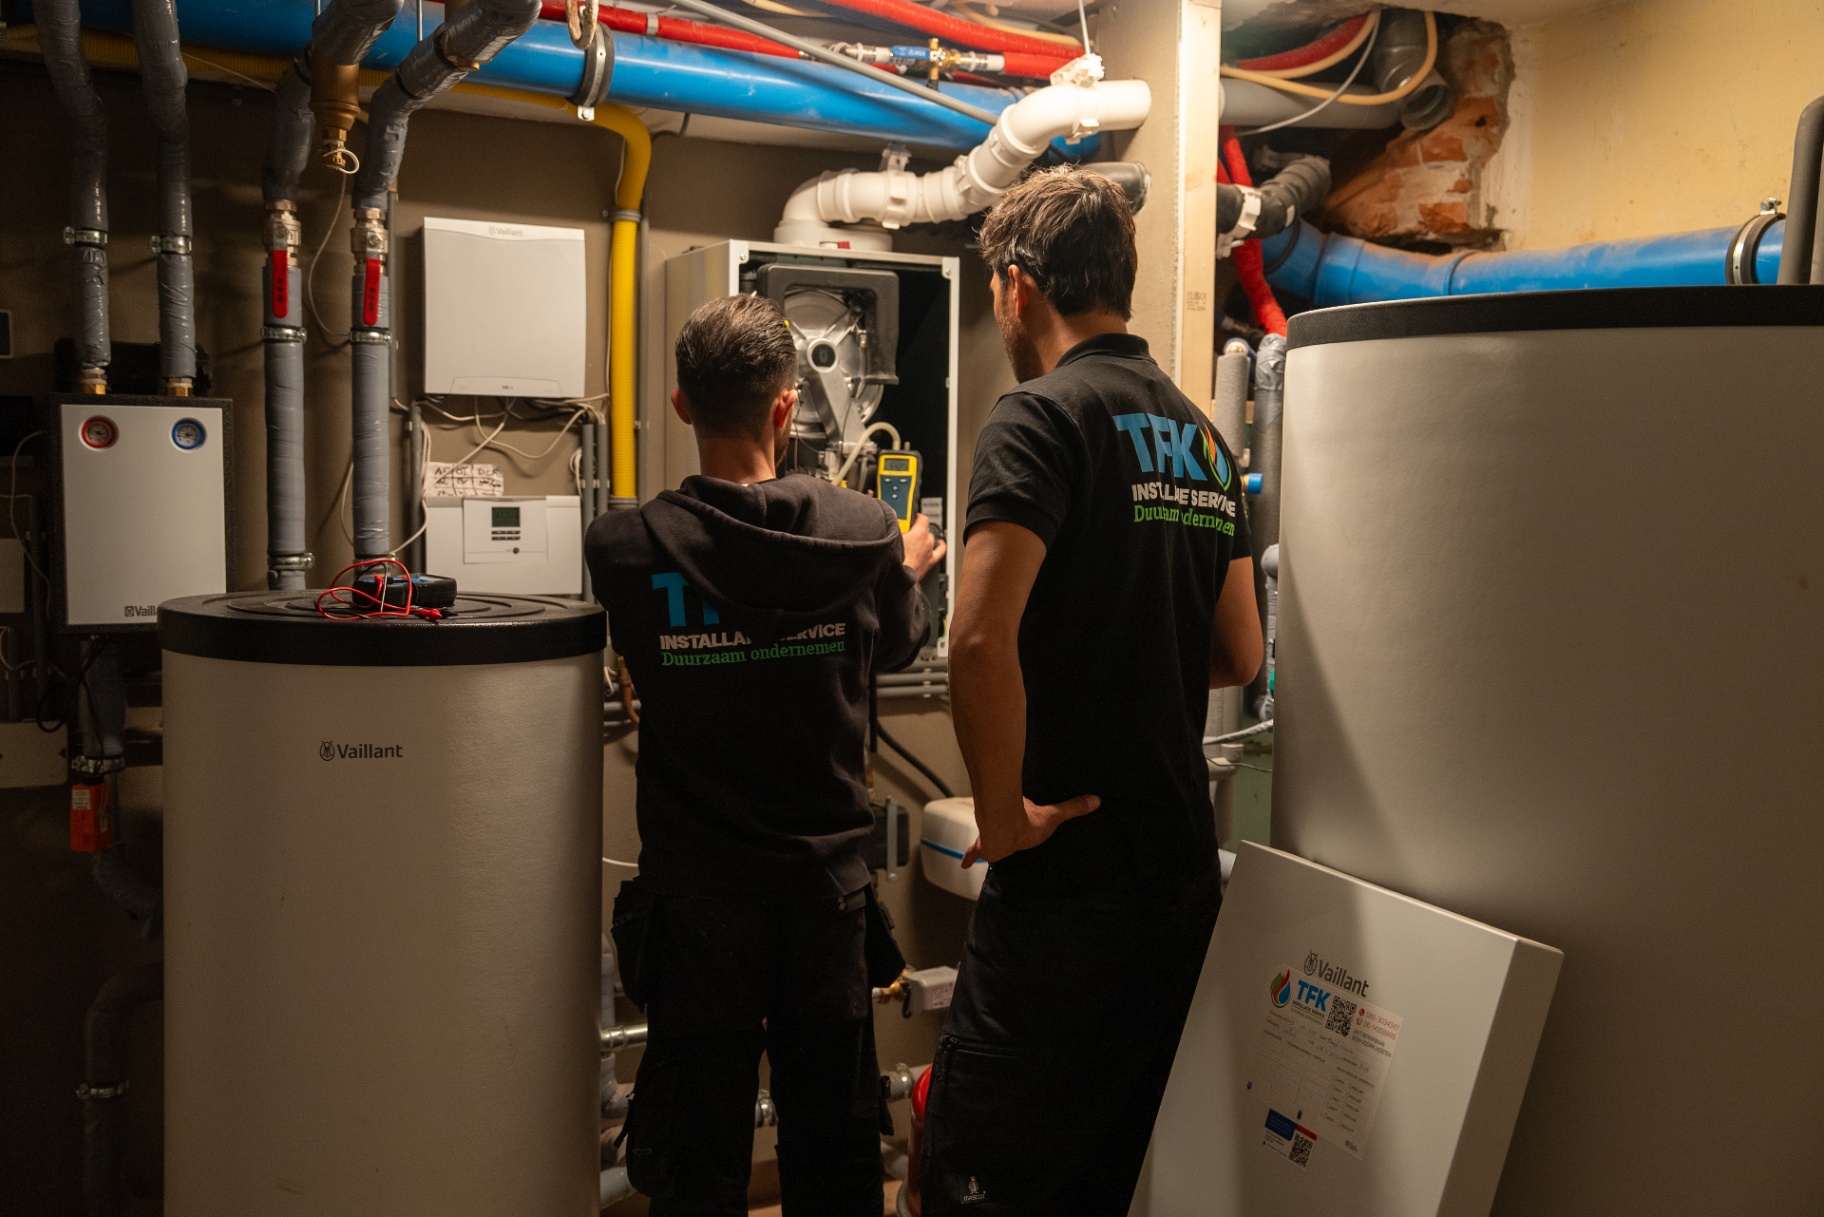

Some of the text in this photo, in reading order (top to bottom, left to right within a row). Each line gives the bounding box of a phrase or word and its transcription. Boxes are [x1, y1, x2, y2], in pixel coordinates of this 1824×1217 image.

[1112, 412, 1208, 481] TFK
[134, 605, 159, 616] Vaill
[659, 630, 752, 650] INSTALLA
[662, 640, 847, 666] Duurzaam ondernemen
[337, 743, 404, 759] Vaillant
[1319, 960, 1369, 997] Vaillant
[1297, 979, 1331, 1012] TFK
